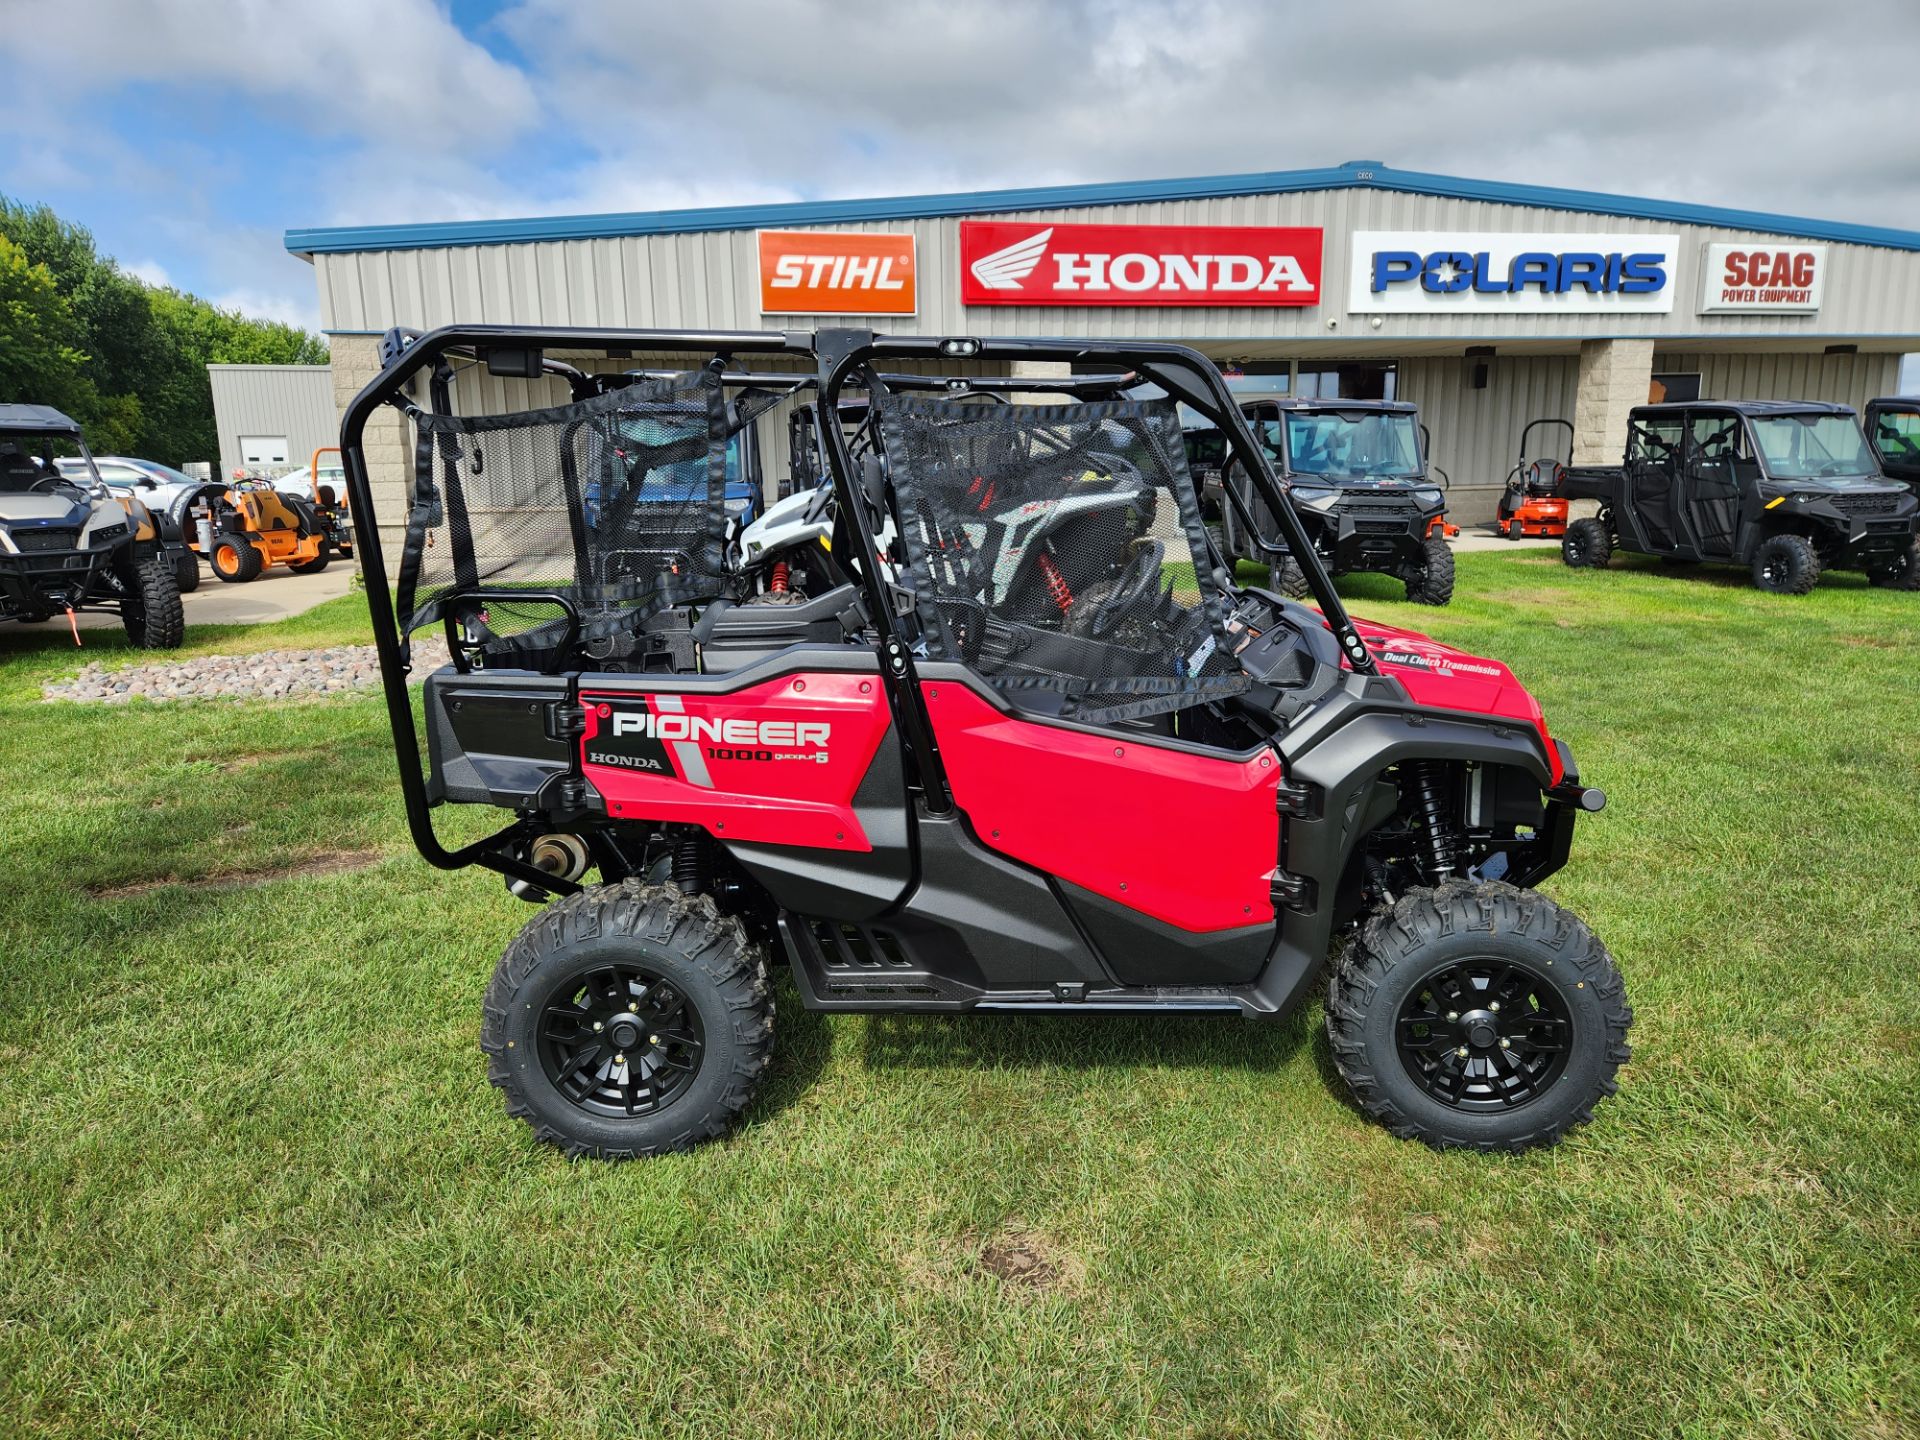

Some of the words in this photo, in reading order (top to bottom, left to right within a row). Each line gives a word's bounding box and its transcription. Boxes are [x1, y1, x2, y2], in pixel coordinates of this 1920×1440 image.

[770, 254, 904, 290] STIHL
[1052, 252, 1315, 292] HONDA
[1370, 250, 1667, 293] POLARIS
[1723, 251, 1816, 288] SCAG
[1721, 289, 1756, 303] POWER
[1758, 289, 1812, 304] EQUIPMENT
[1383, 652, 1409, 664] Dual
[1409, 655, 1440, 668] Clutch
[1441, 659, 1501, 676] Transmission
[613, 711, 831, 747] PIONEER
[589, 752, 663, 770] HONDA
[707, 747, 773, 762] 1000
